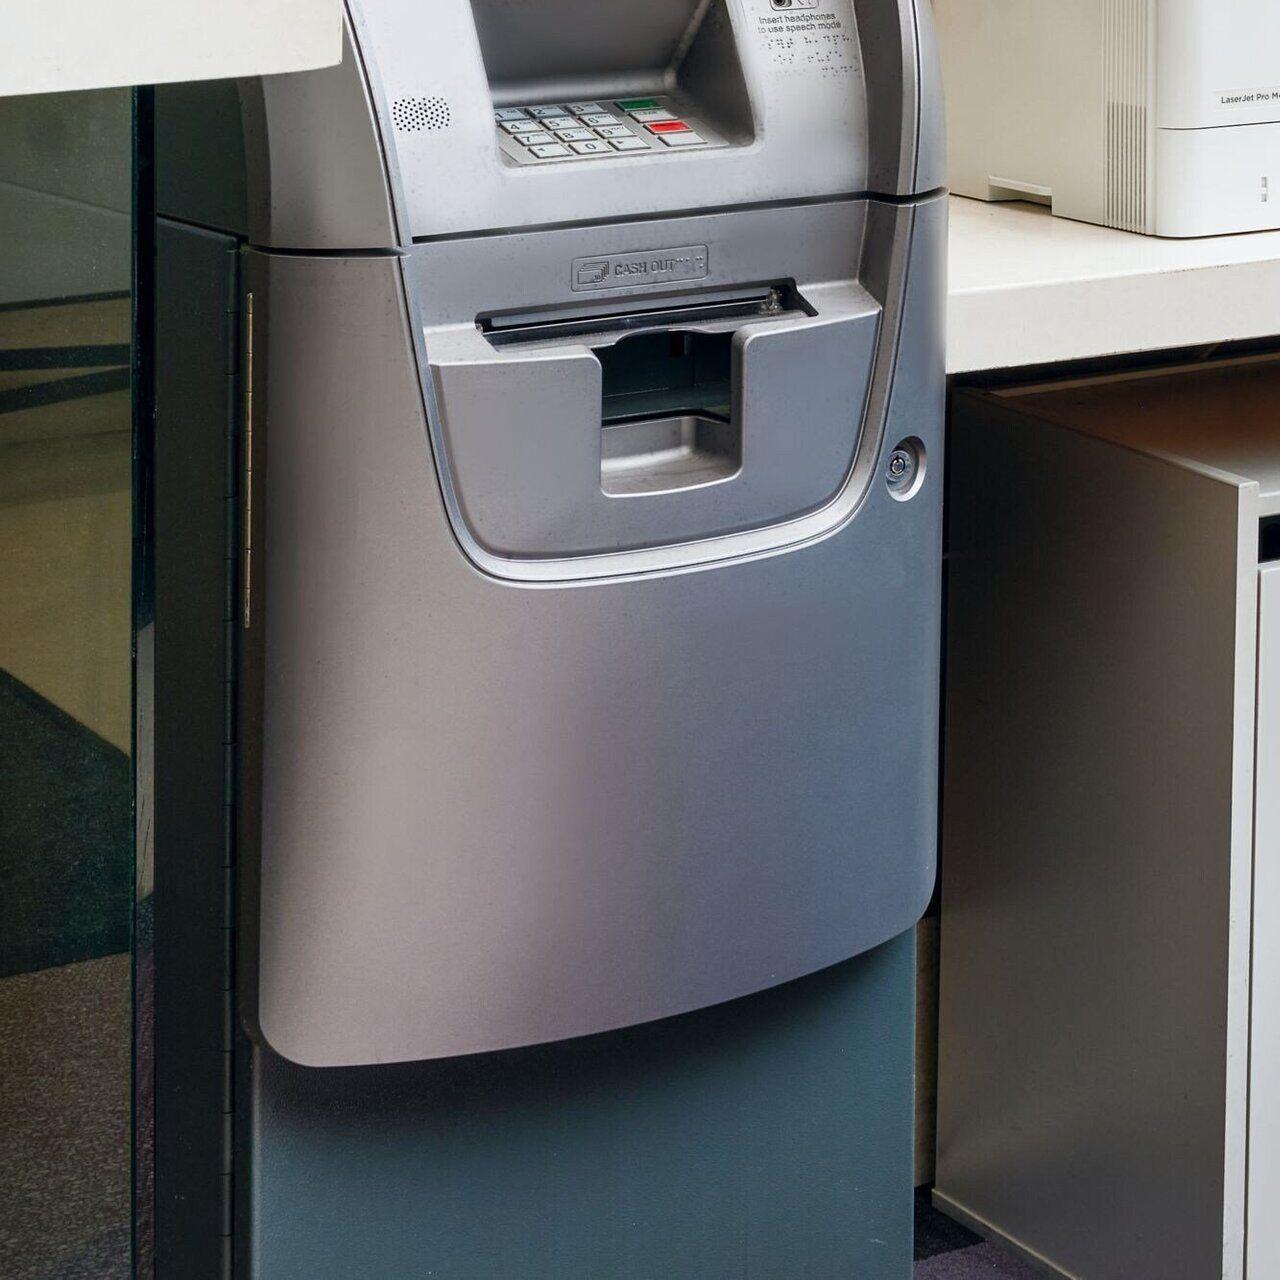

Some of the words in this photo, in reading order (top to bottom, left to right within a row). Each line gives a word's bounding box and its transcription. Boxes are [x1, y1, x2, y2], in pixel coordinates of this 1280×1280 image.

[758, 16, 783, 24] Insert
[784, 13, 836, 23] headphones
[757, 26, 766, 34] to
[786, 22, 816, 33] speech
[818, 21, 841, 30] mode
[1221, 94, 1254, 104] LaserJet
[1256, 93, 1270, 101] Pro
[614, 262, 648, 276] CASH
[650, 259, 674, 273] OUT
